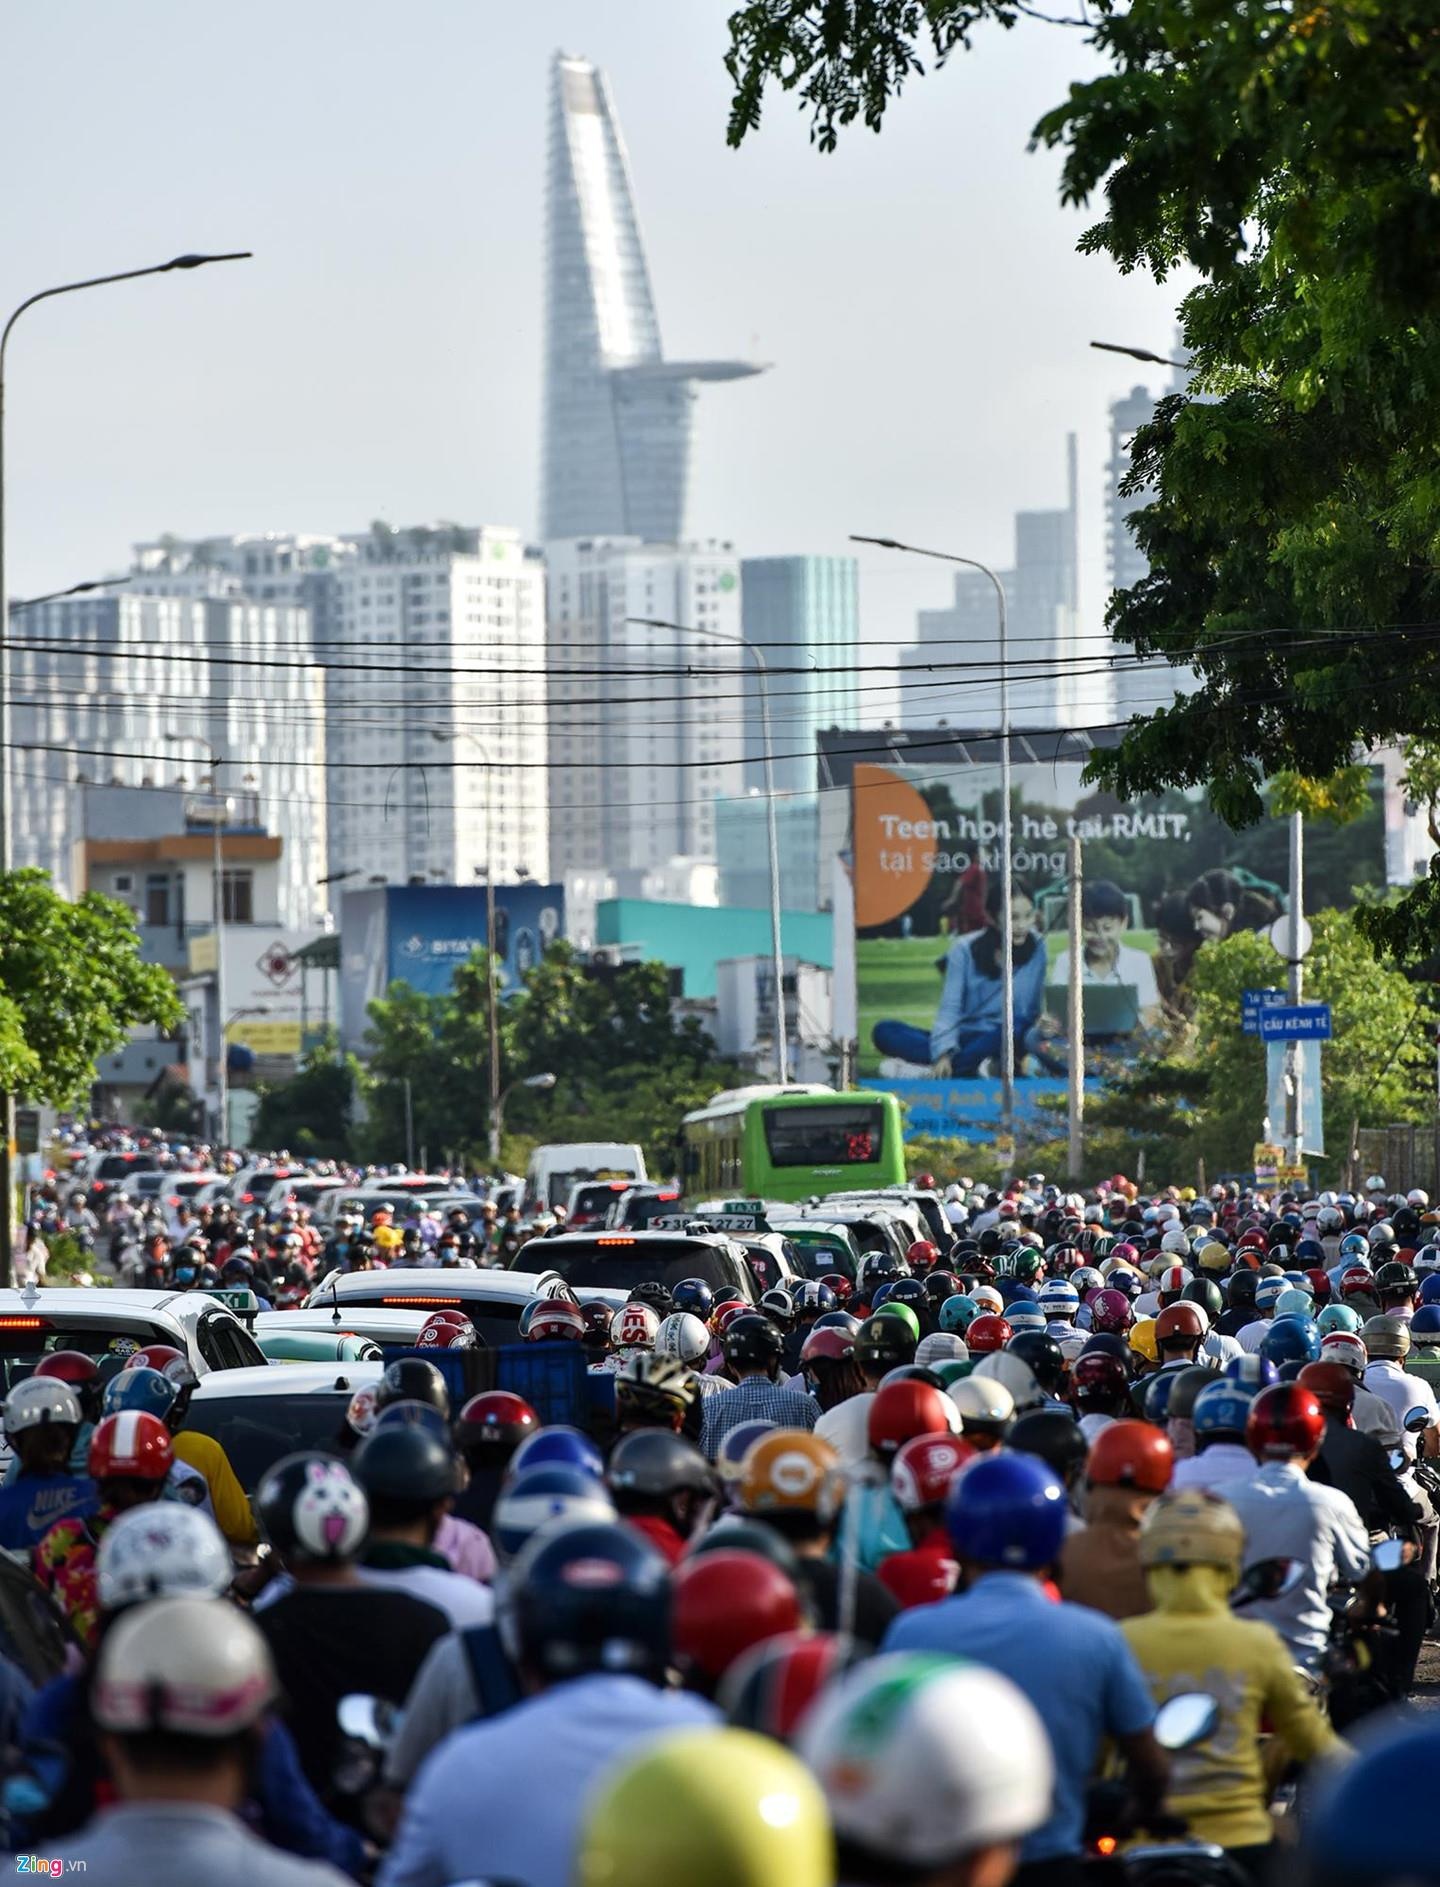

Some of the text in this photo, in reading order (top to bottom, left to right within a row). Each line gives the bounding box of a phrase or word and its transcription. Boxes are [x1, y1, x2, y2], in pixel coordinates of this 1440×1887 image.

[879, 814, 1193, 846] Teen học hè tại RMIT,
[880, 846, 1067, 878] tại sao không
[730, 1202, 757, 1213] TAXI
[716, 1219, 732, 1230] 27
[736, 1219, 754, 1230] 27
[35, 1487, 77, 1512] NIKE
